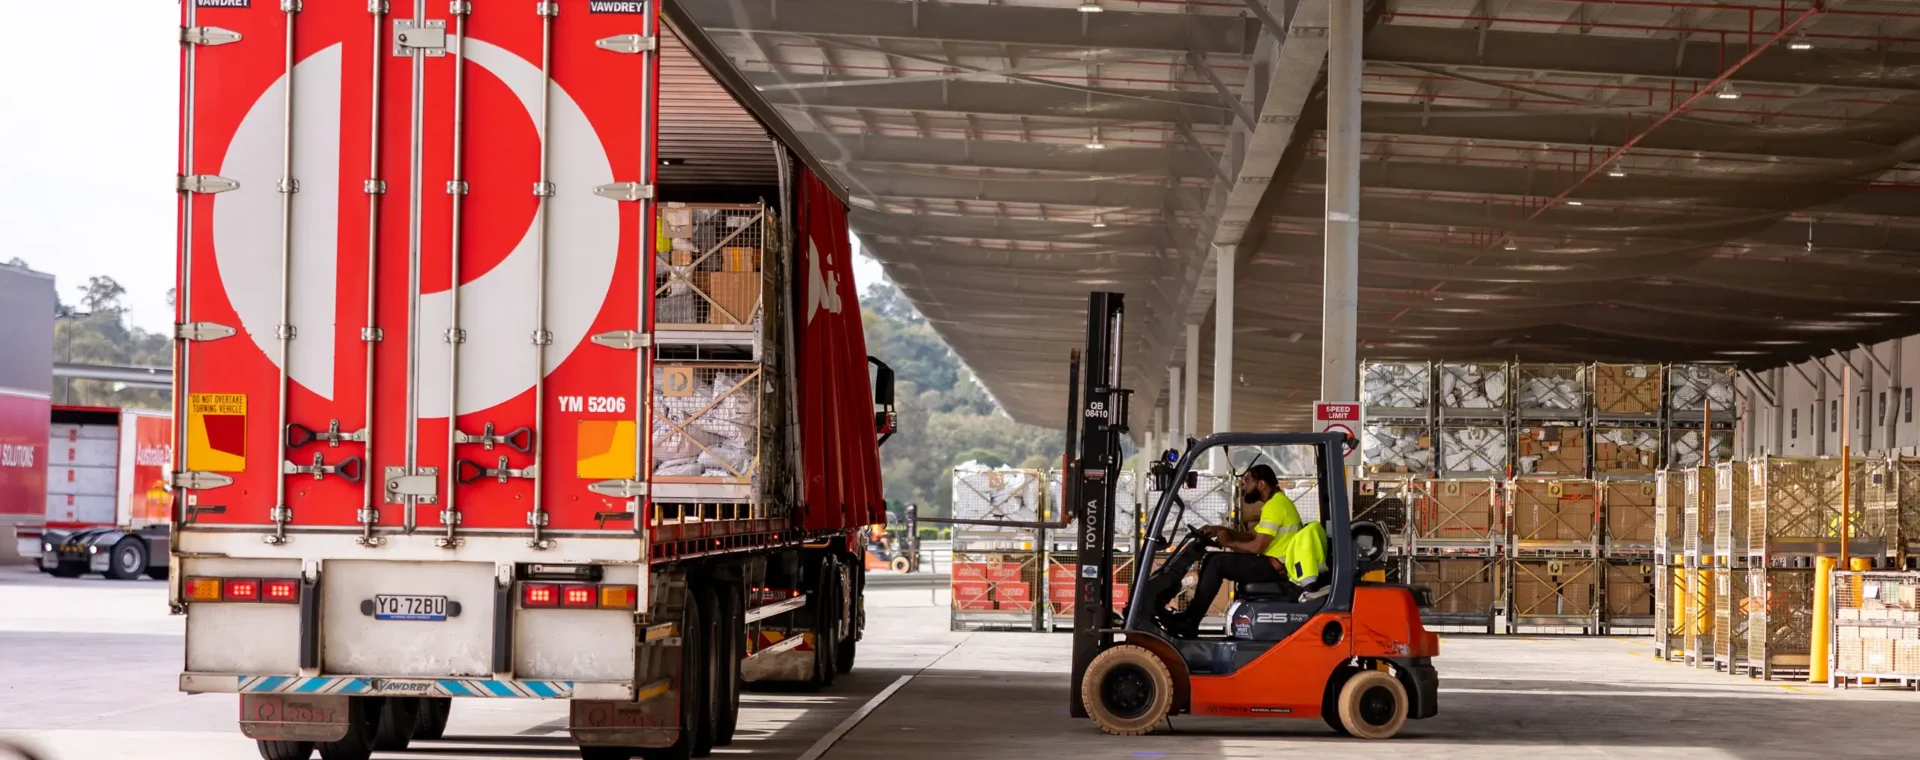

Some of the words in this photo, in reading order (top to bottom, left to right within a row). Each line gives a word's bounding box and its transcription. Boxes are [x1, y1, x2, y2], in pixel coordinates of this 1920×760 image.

[590, 2, 643, 12] VAWDREY
[192, 394, 200, 404] DO
[202, 395, 213, 404] NOT
[215, 395, 243, 404] OVERTAKE
[558, 396, 583, 412] YM
[588, 396, 626, 413] 5206
[193, 404, 217, 413] TURNING
[219, 404, 243, 414] VEHICLE
[1090, 401, 1104, 410] QB
[1085, 409, 1108, 418] 08410
[2, 444, 34, 468] SOLUTIONS
[136, 443, 164, 466] Australia
[1086, 499, 1098, 551] TOYOTA
[1257, 612, 1288, 623] 25
[378, 680, 431, 692] VAWDREY
[287, 707, 336, 722] POST
